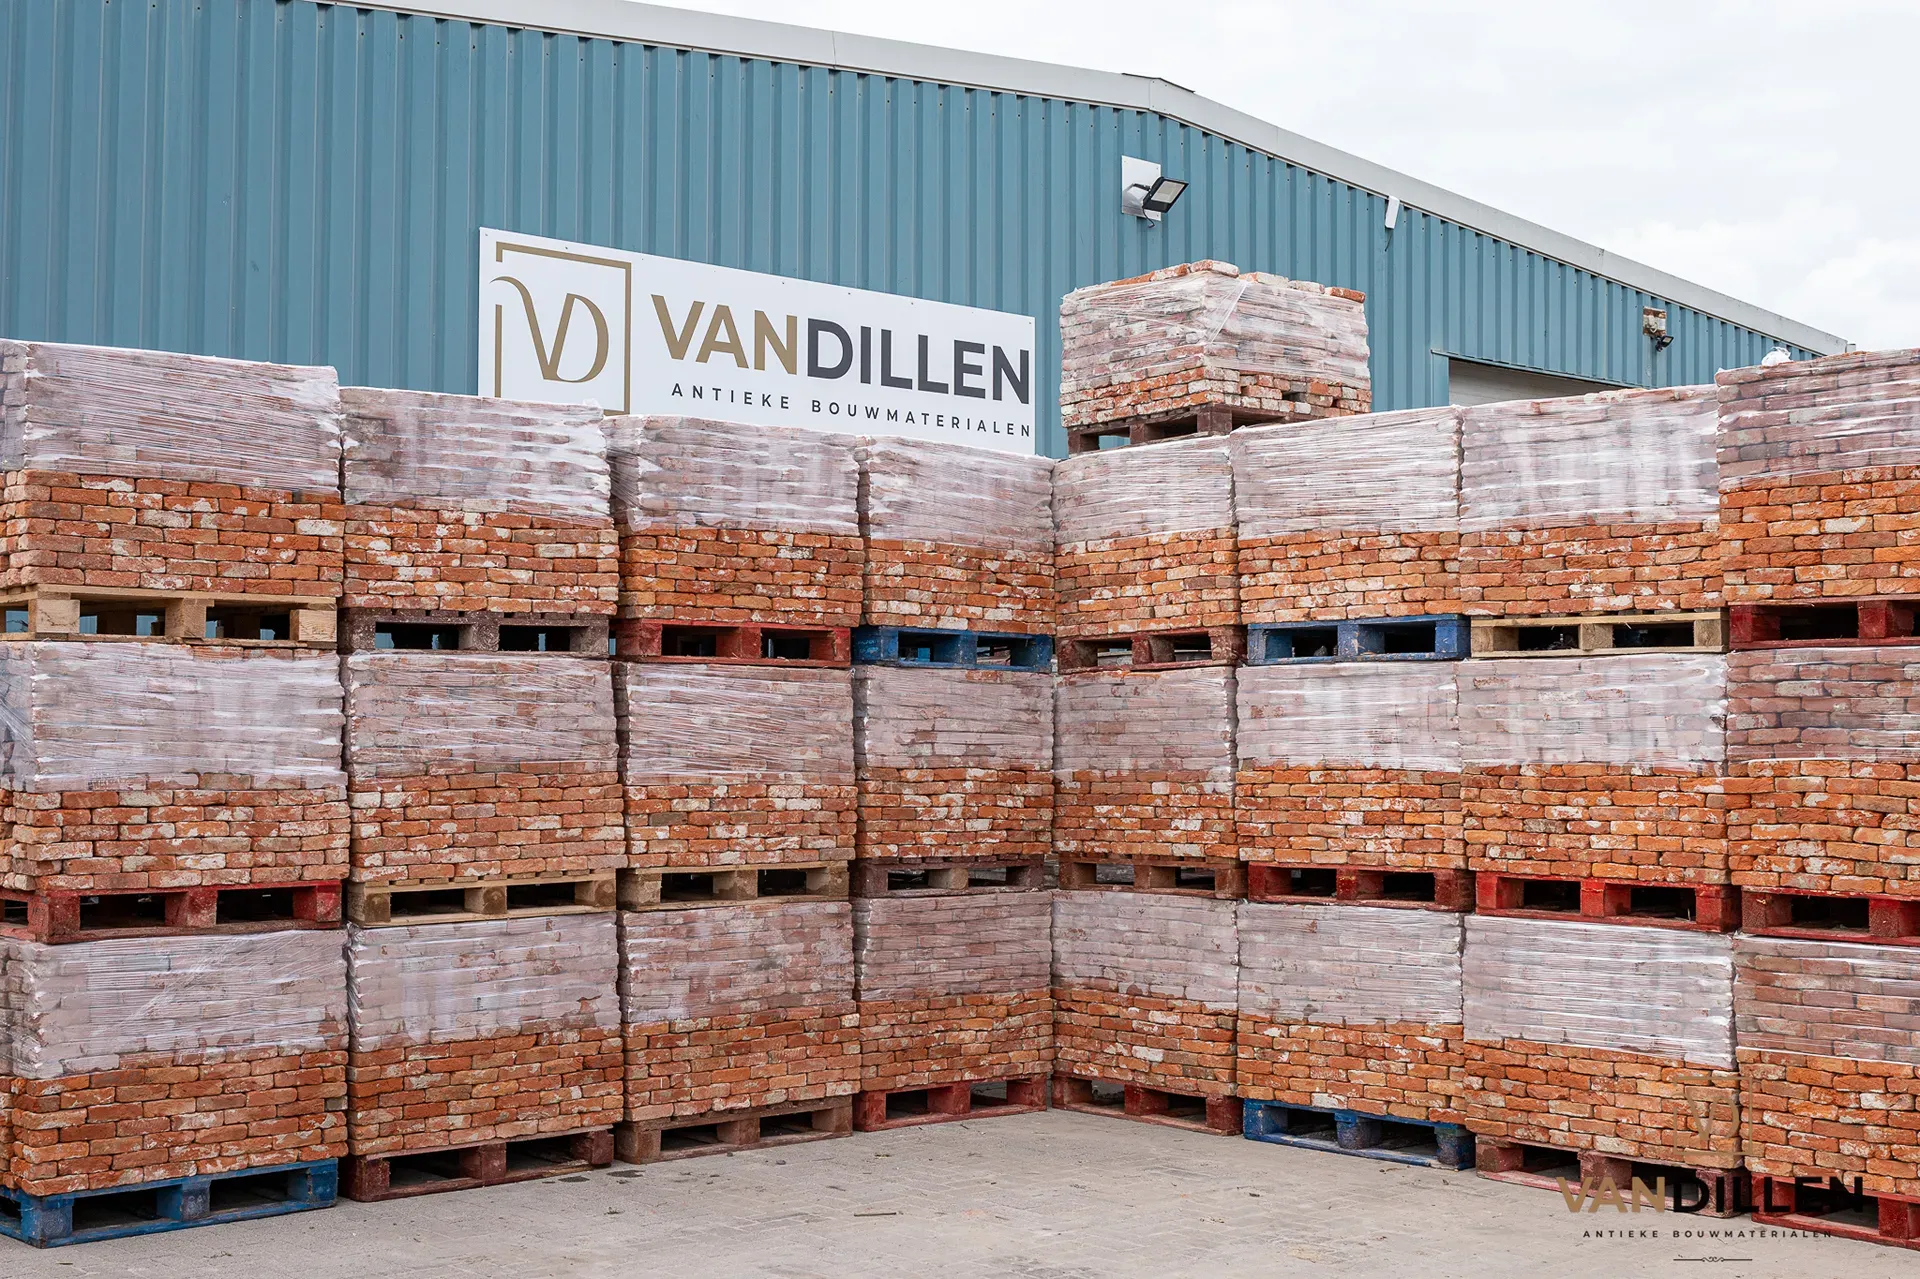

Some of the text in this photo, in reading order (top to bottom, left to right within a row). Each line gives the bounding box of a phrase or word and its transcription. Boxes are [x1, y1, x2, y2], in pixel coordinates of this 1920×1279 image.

[650, 294, 1030, 405] VANDILLEN
[671, 382, 1031, 438] ANTIEKE BOUWMATERIALEN
